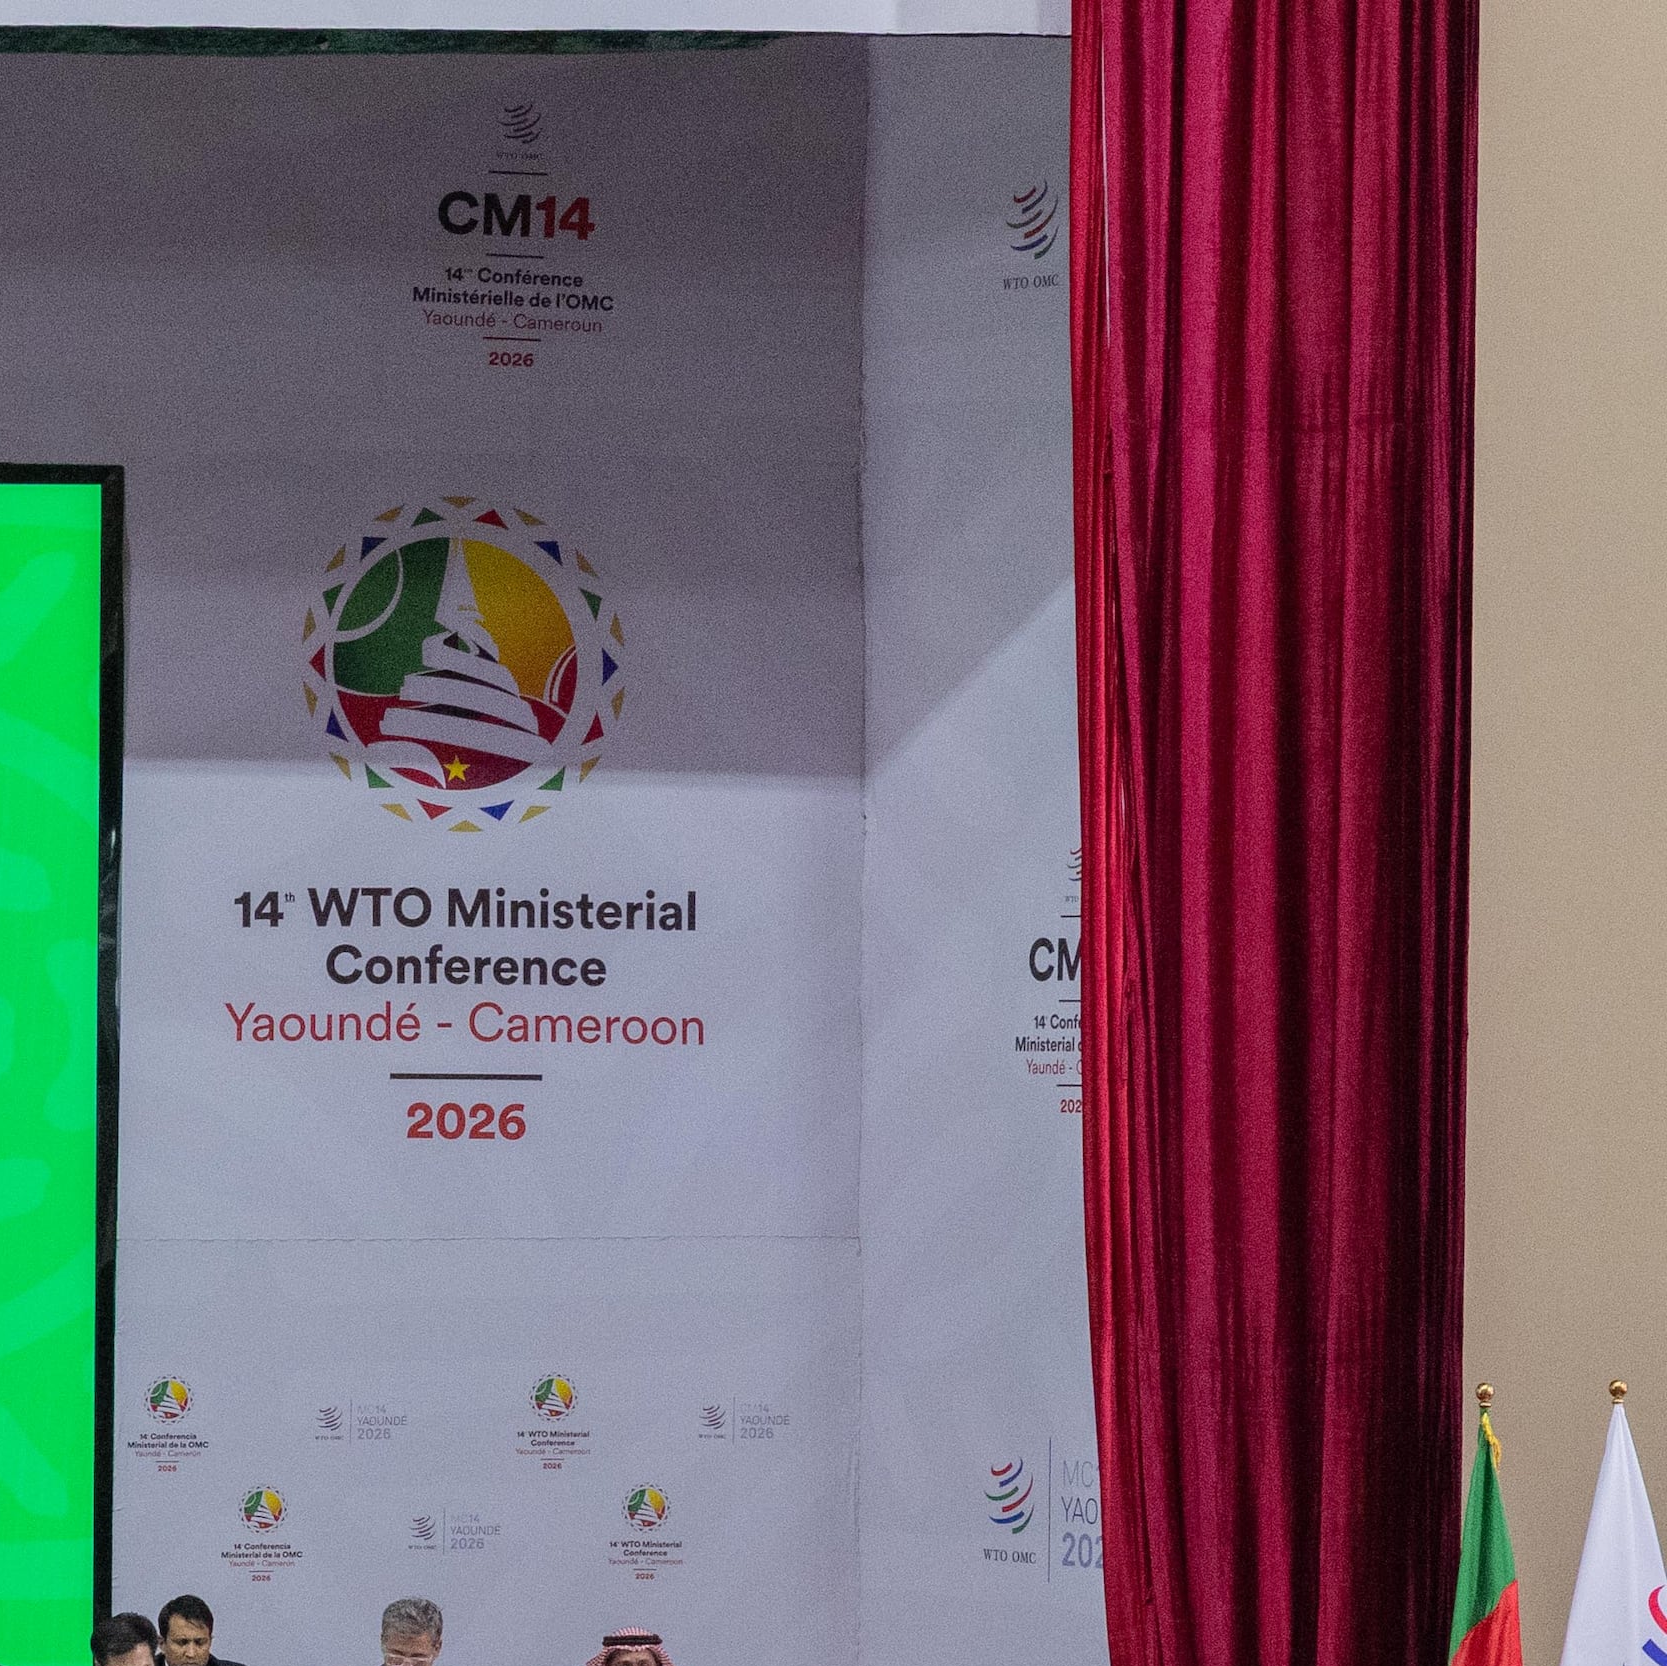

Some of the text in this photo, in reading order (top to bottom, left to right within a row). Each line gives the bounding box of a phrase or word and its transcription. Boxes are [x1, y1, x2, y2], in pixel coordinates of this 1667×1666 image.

[439, 191, 594, 239] CM14
[478, 267, 583, 287] Conférence
[413, 287, 614, 311] Ministérielle de l'OMC
[489, 352, 534, 367] 2026
[308, 888, 431, 927] WTO
[449, 889, 695, 930] Ministerial
[327, 944, 606, 986] Conference
[226, 1002, 703, 1045] Yaoundé Cameroon
[408, 1103, 525, 1140] 2026
